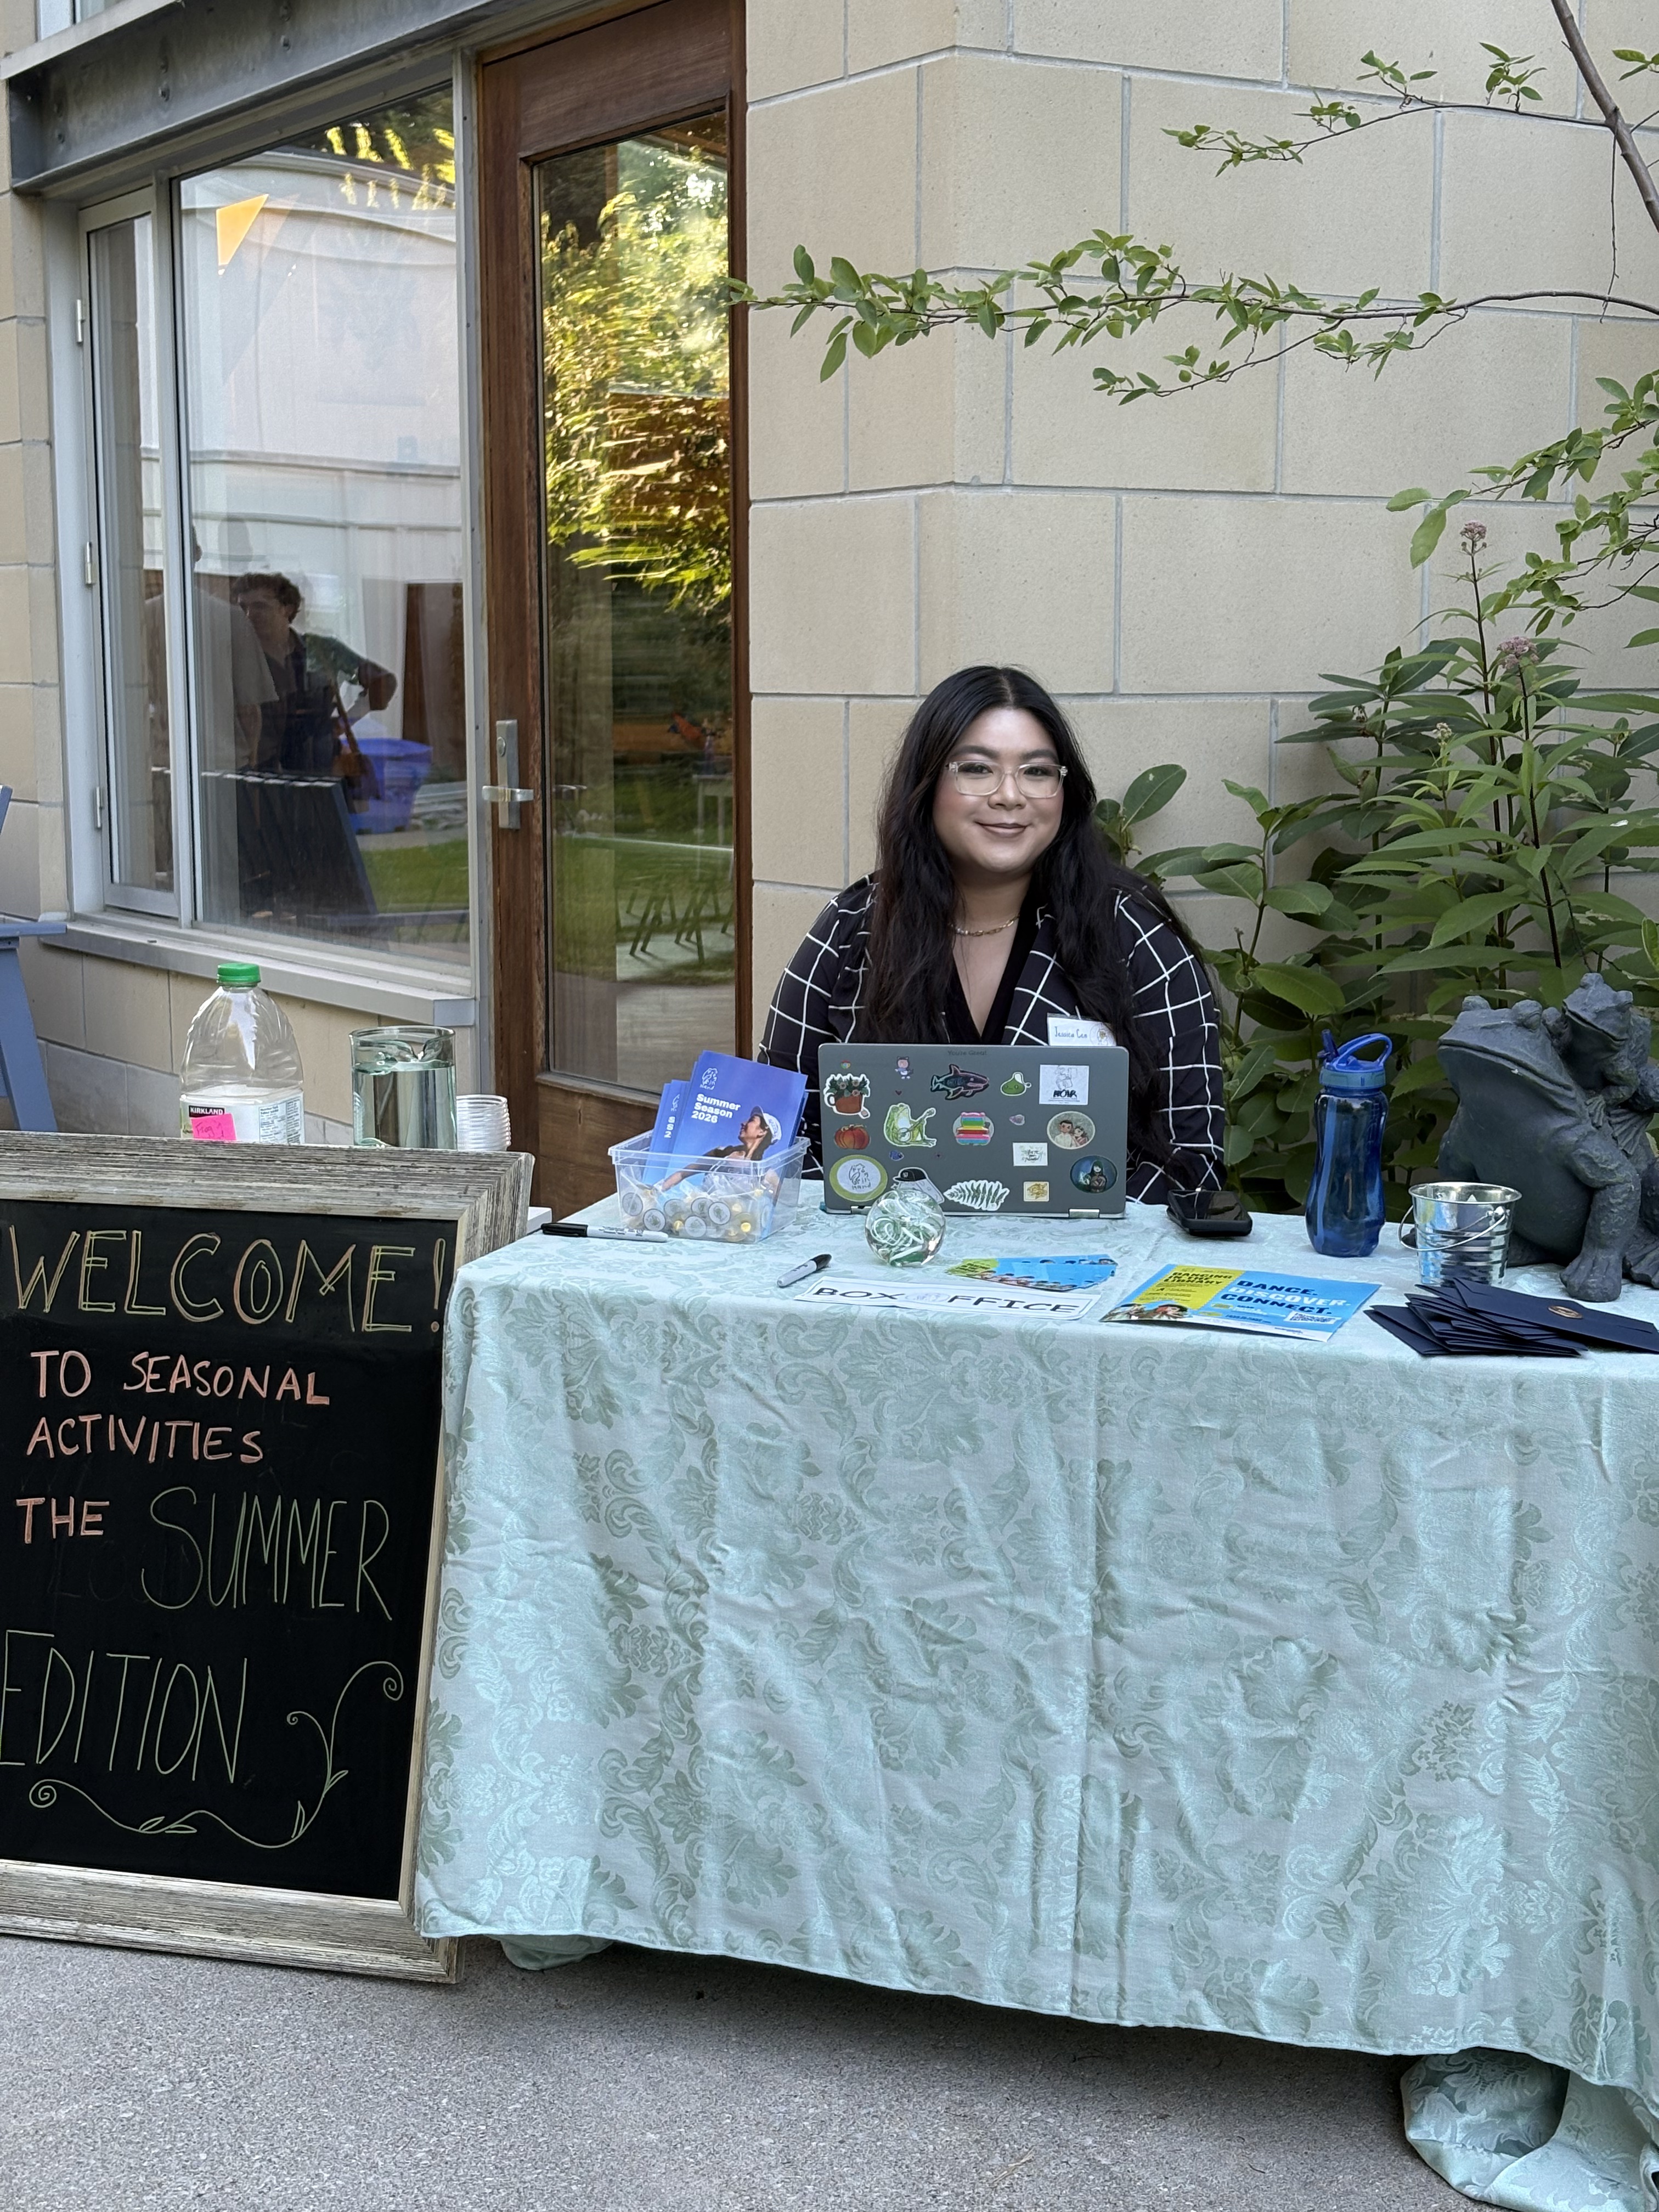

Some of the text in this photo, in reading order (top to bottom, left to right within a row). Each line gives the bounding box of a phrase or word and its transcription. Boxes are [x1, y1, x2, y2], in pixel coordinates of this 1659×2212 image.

[1054, 1026, 1074, 1038] Jessica
[190, 1107, 223, 1115] KIRKLAND
[694, 1102, 733, 1118] Season
[696, 1093, 741, 1111] Summer
[691, 1111, 718, 1123] 2026
[9, 1224, 445, 1333] WELCOME!
[812, 1287, 905, 1300] BOX
[1228, 1287, 1351, 1306] DISCOVER.
[1237, 1280, 1318, 1296] DANCE.
[1220, 1294, 1332, 1314] CONNECT.
[31, 1350, 330, 1404] TO SEASONAL
[26, 1414, 263, 1463] ACTIVITIES
[16, 1496, 109, 1544] THE
[141, 1486, 393, 1621] SUMMER
[0, 1630, 247, 1783] EDITION
